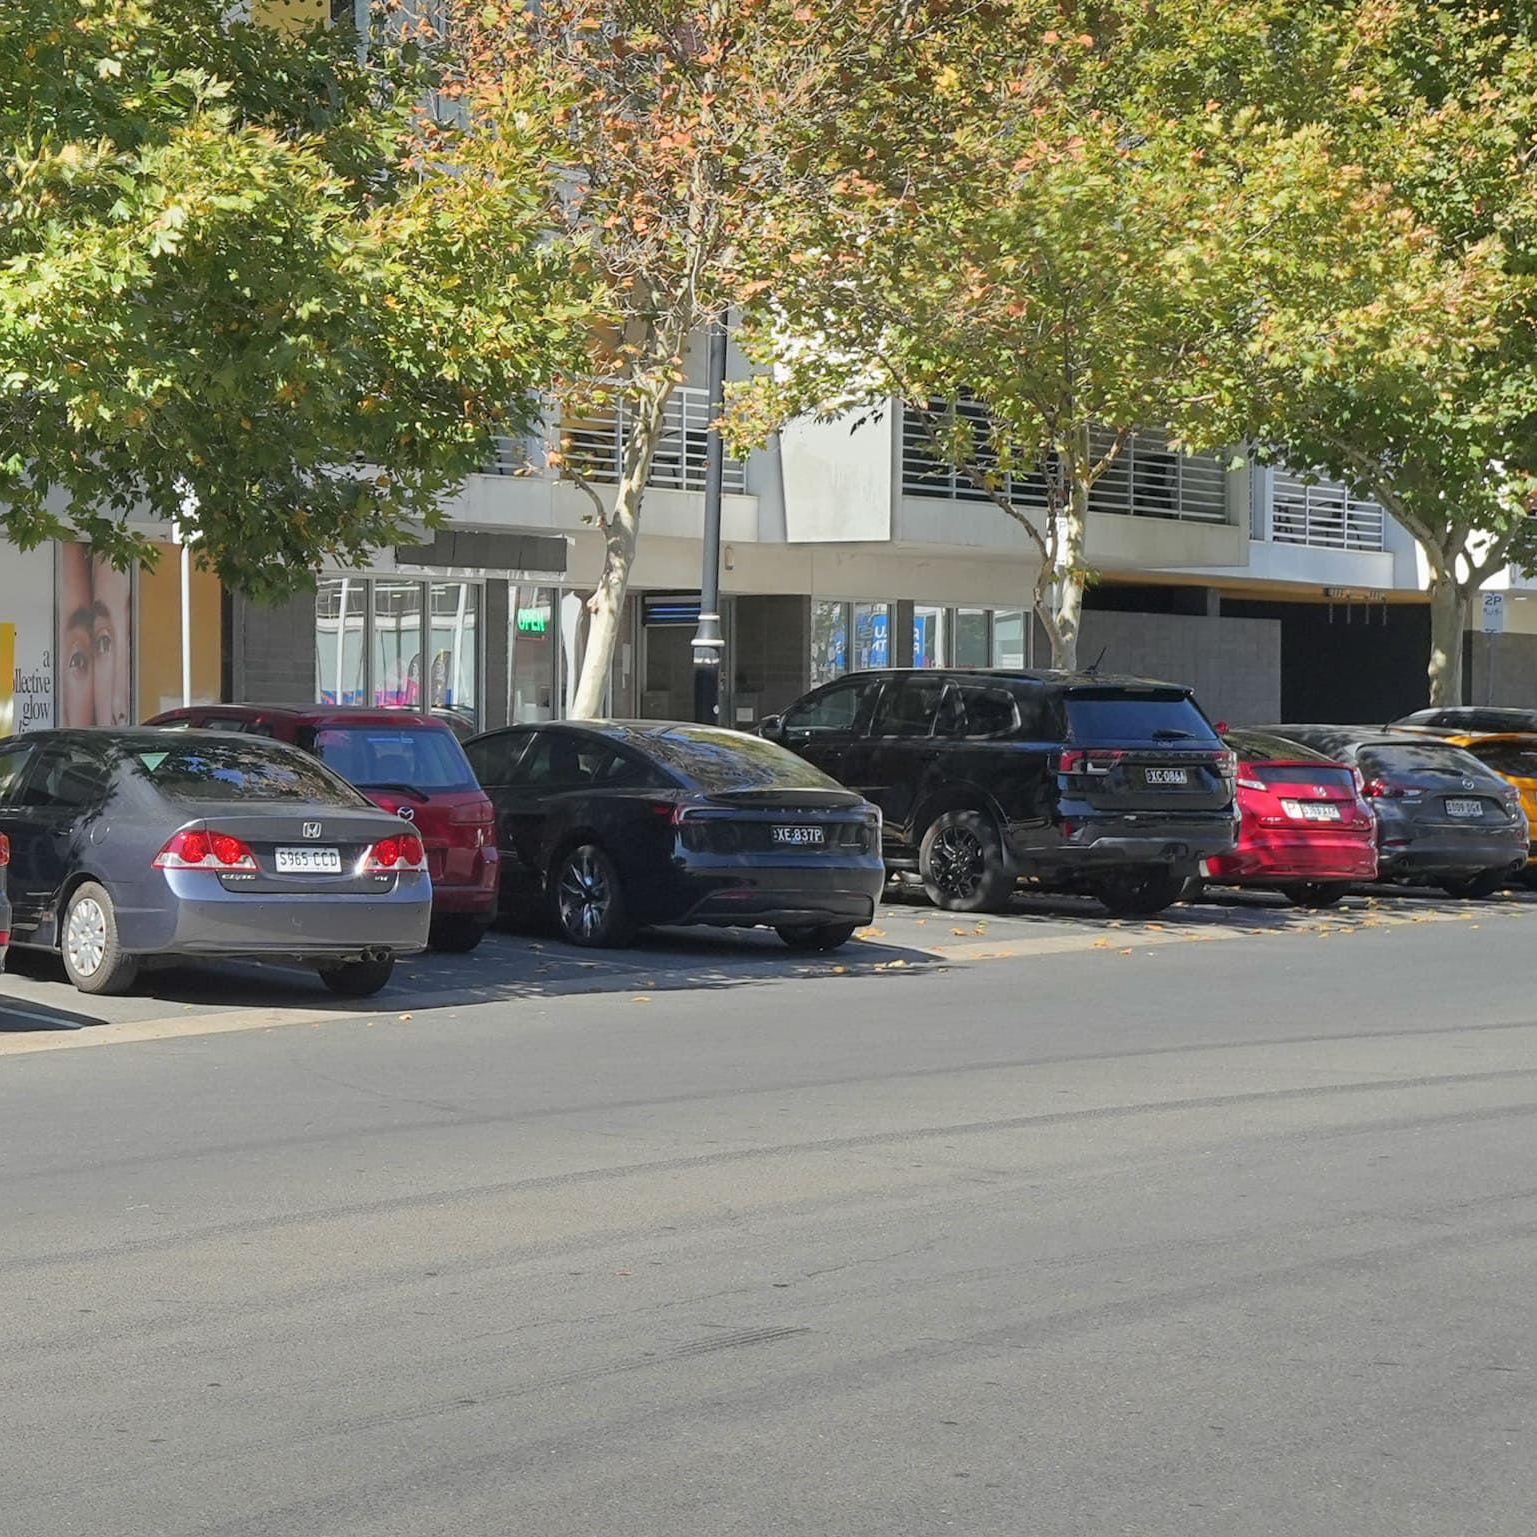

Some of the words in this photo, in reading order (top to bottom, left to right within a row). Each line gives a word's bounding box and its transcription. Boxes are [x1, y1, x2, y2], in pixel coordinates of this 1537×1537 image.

[1484, 595, 1502, 606] 2P
[517, 607, 546, 633] OPEN
[42, 650, 51, 668] a
[13, 667, 51, 694] llective
[22, 694, 51, 727] glow
